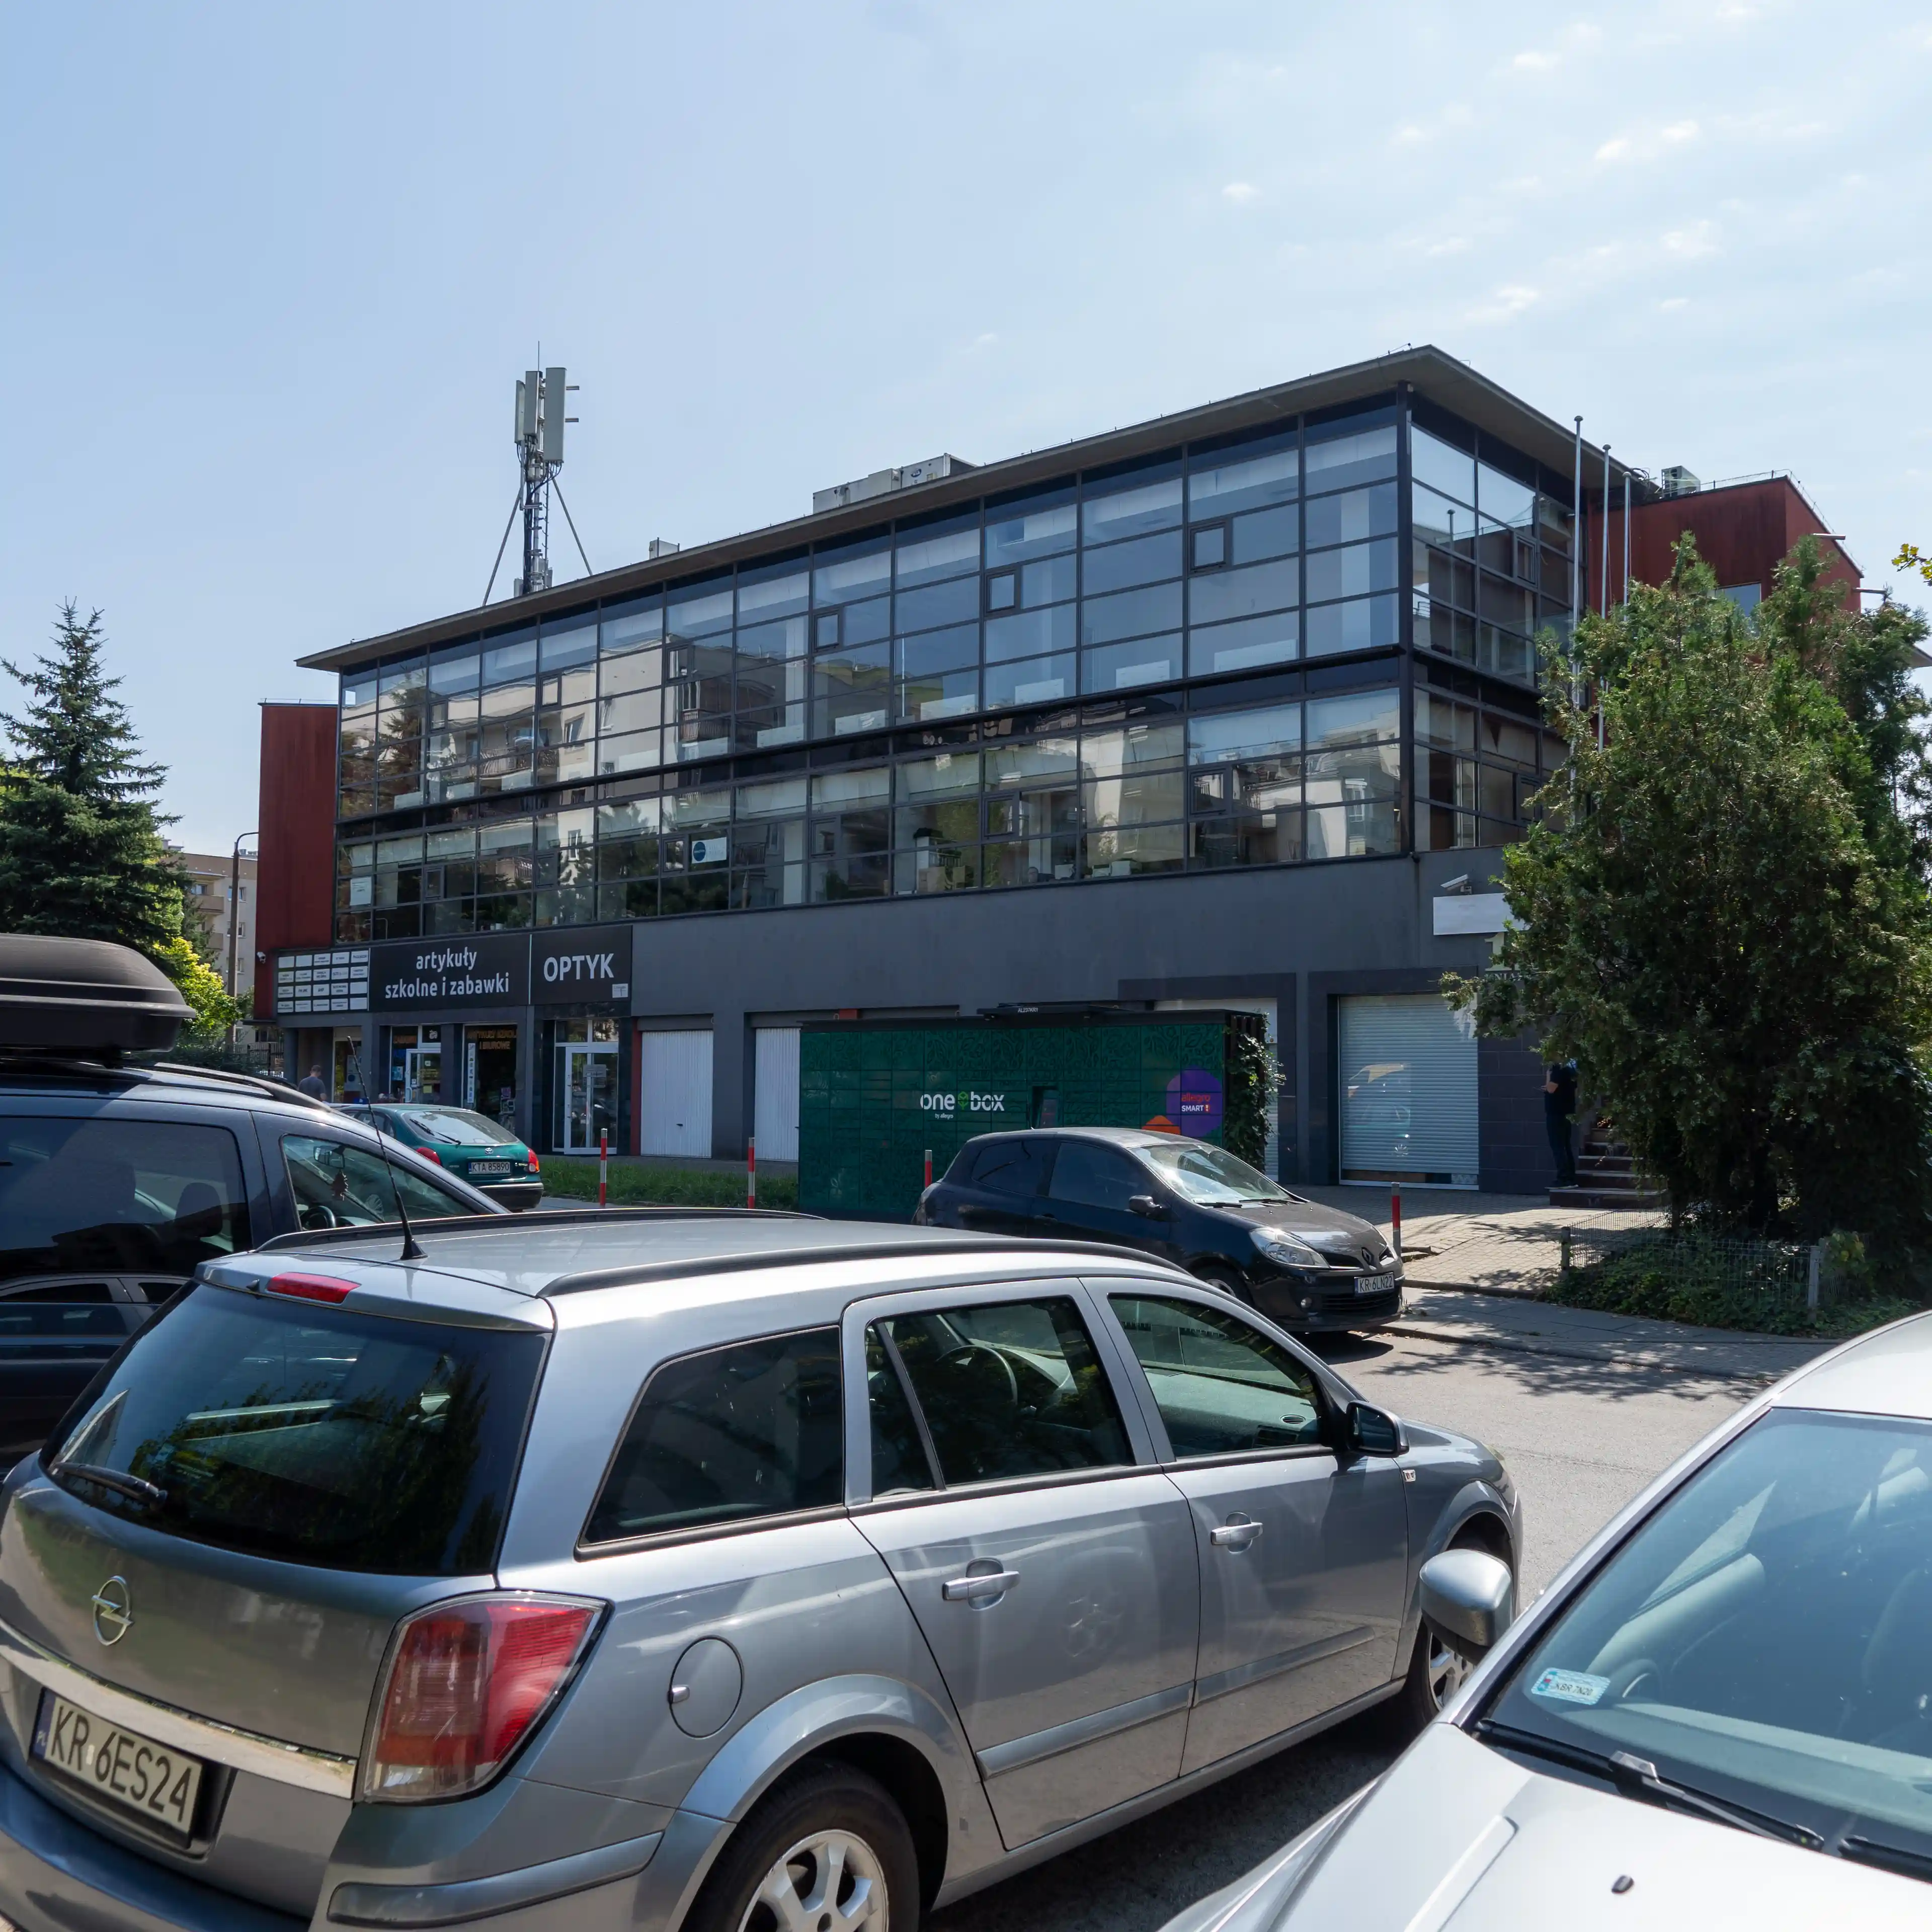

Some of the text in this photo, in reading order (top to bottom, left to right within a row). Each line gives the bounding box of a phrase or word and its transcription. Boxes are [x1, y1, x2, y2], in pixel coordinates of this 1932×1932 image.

[416, 946, 477, 973] artykuły
[543, 953, 614, 982] OPTYK
[385, 973, 509, 999] szkolne i zabawki
[920, 1091, 1005, 1111] one box
[1181, 1092, 1211, 1104] allegro
[472, 1162, 509, 1171] KTA 85890
[1360, 1276, 1393, 1292] KR 6LN22
[51, 1705, 192, 1823] KR 6ES24
